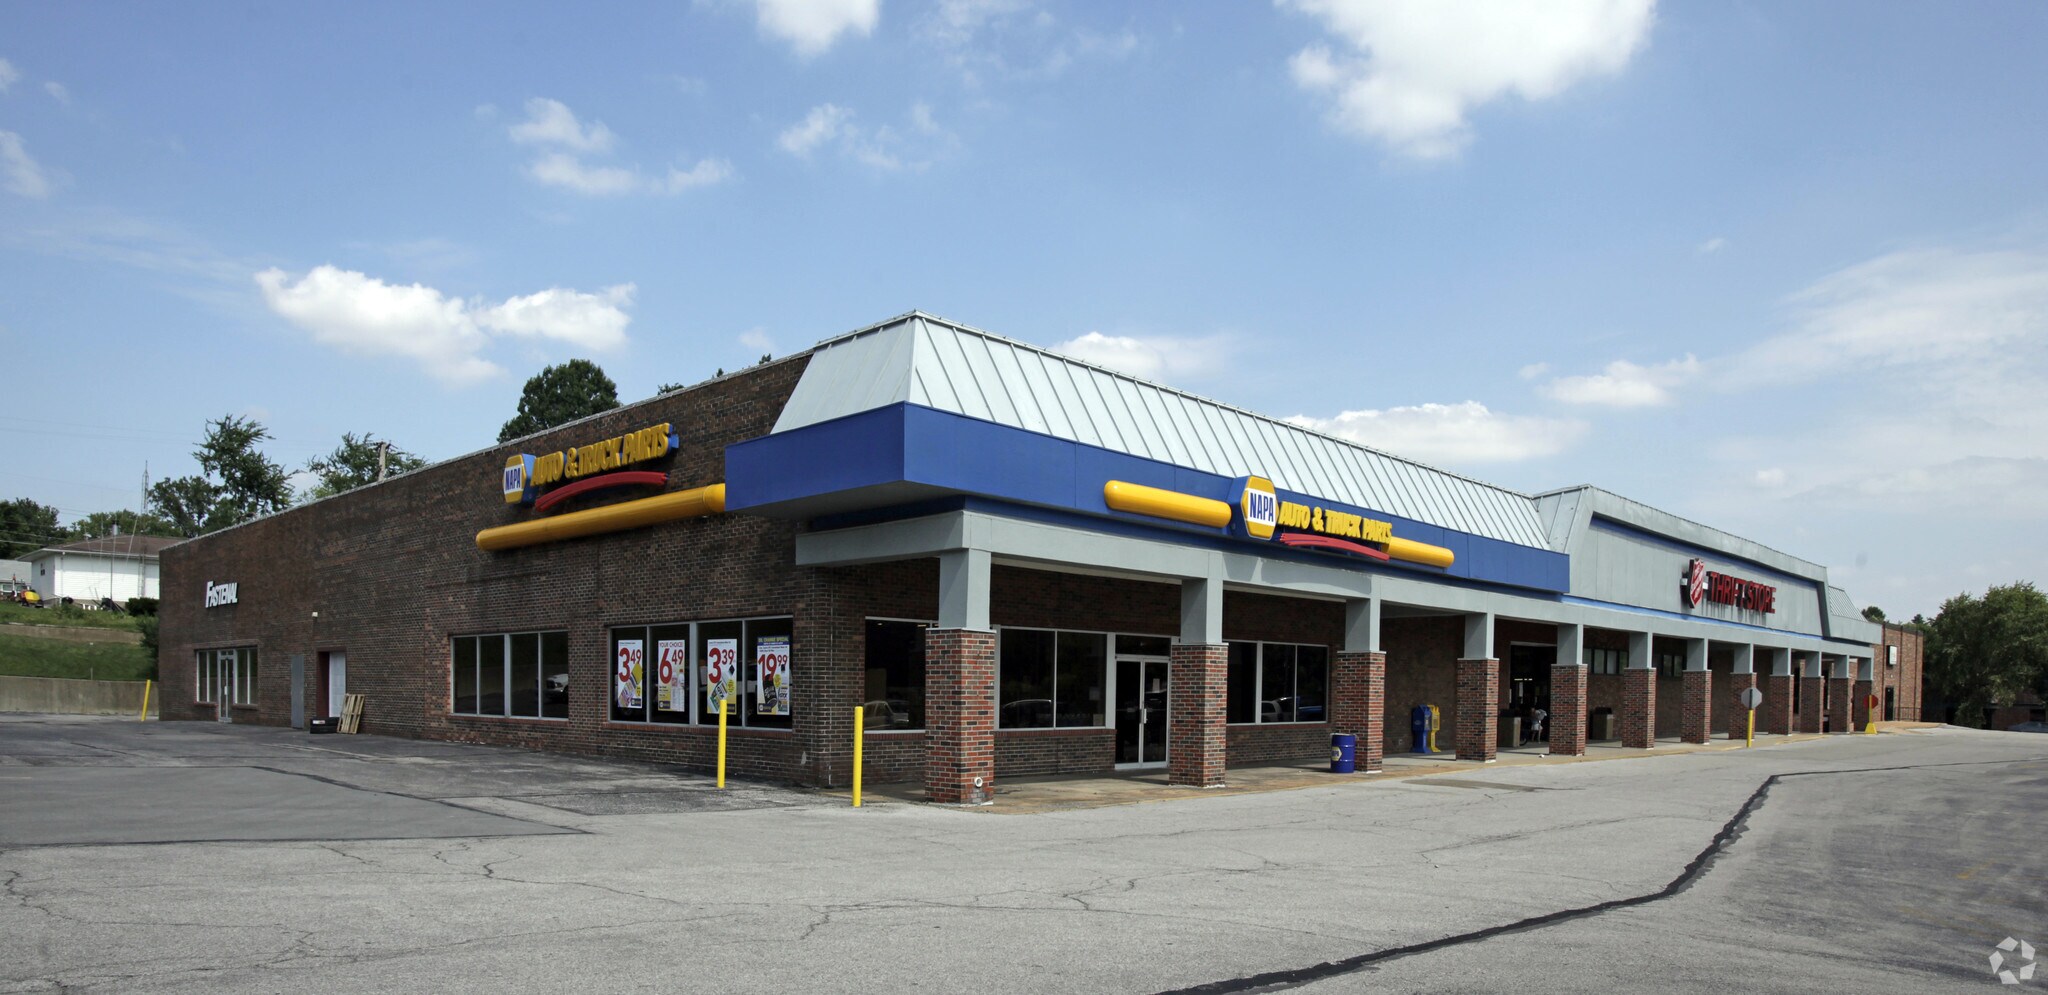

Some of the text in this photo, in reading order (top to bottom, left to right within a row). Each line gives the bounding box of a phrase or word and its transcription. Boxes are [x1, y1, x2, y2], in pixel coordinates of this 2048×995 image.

[505, 423, 669, 491] NAPA AUTO & TRUCK PARTS
[1249, 492, 1393, 544] NAPA AUTO & TRUCK PARTS
[1707, 571, 1747, 608] THRIFT
[1747, 580, 1777, 614] STORE
